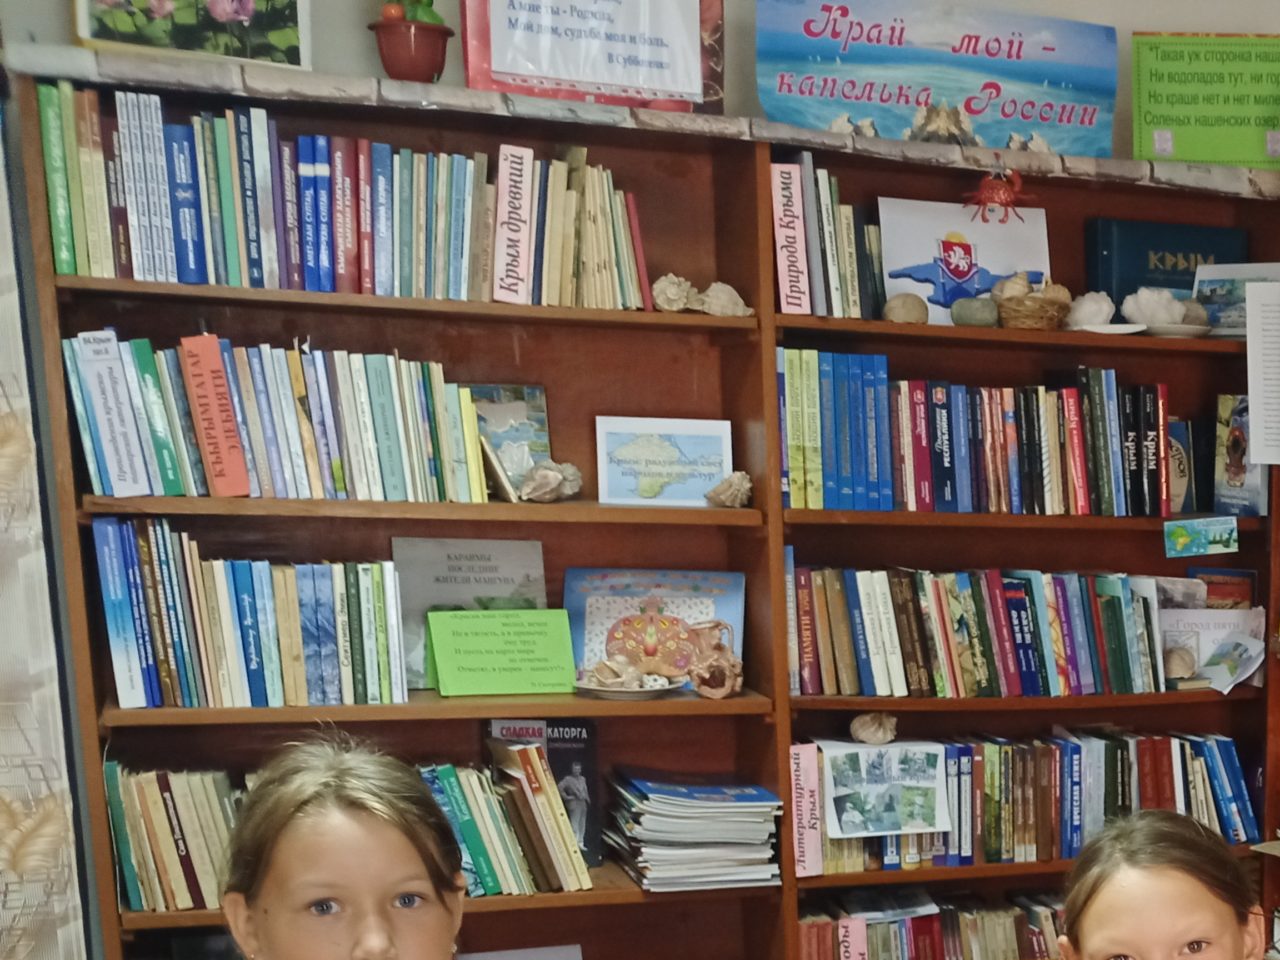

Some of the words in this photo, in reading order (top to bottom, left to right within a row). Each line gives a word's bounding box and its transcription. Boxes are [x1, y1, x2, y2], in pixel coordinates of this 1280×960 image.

[802, 3, 907, 54] Край
[951, 31, 1025, 60] мой
[1149, 68, 1163, 84] Ни
[1166, 70, 1226, 87] водопадов
[1250, 73, 1262, 84] ни
[1203, 49, 1253, 64] сторонка
[775, 71, 935, 109] капелька
[962, 81, 1098, 128] России
[1148, 91, 1163, 106] Но
[1165, 92, 1200, 109] краше
[1201, 93, 1220, 106] нет
[1223, 94, 1231, 106] и
[1233, 94, 1253, 106] нет
[501, 151, 528, 234] древний
[779, 170, 799, 231] Крыма
[500, 243, 524, 295] Крым
[780, 236, 806, 308] Природа
[1147, 250, 1215, 271] КРЫМ
[187, 351, 226, 478] КЪЫРЫМТАТАР
[940, 409, 951, 467] РЕСПУБЛИКИ
[1125, 431, 1137, 470] Крым
[1143, 431, 1157, 470] Крым
[802, 615, 814, 662] ПАМЯТИ
[500, 727, 543, 738] СЛАДКАЯ
[547, 727, 588, 739] КАТОРГА
[792, 751, 806, 870] Литературный
[807, 789, 820, 831] Крым
